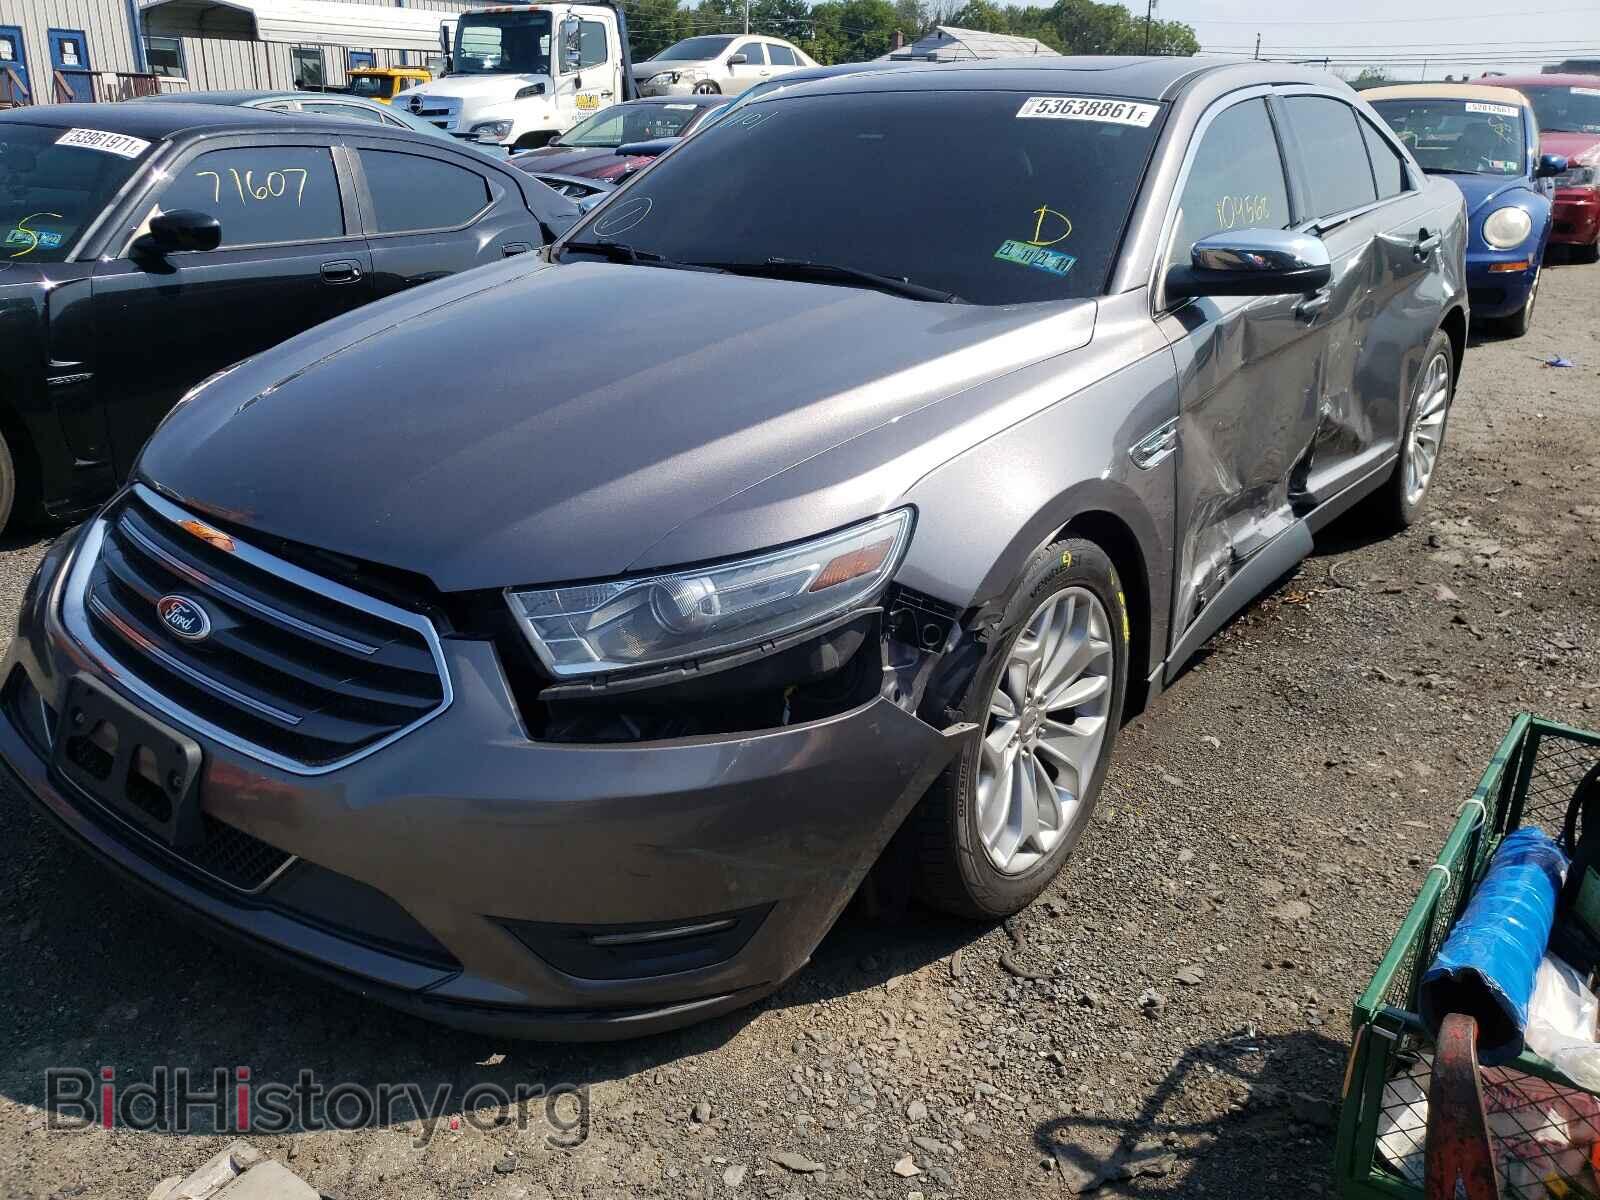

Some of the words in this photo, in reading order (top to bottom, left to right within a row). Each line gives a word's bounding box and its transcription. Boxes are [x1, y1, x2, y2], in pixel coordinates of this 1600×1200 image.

[1035, 99, 1138, 120] 53638861
[70, 130, 137, 152] 53961971
[195, 168, 307, 208] 71607
[1026, 204, 1072, 246] D
[165, 602, 196, 630] Ford
